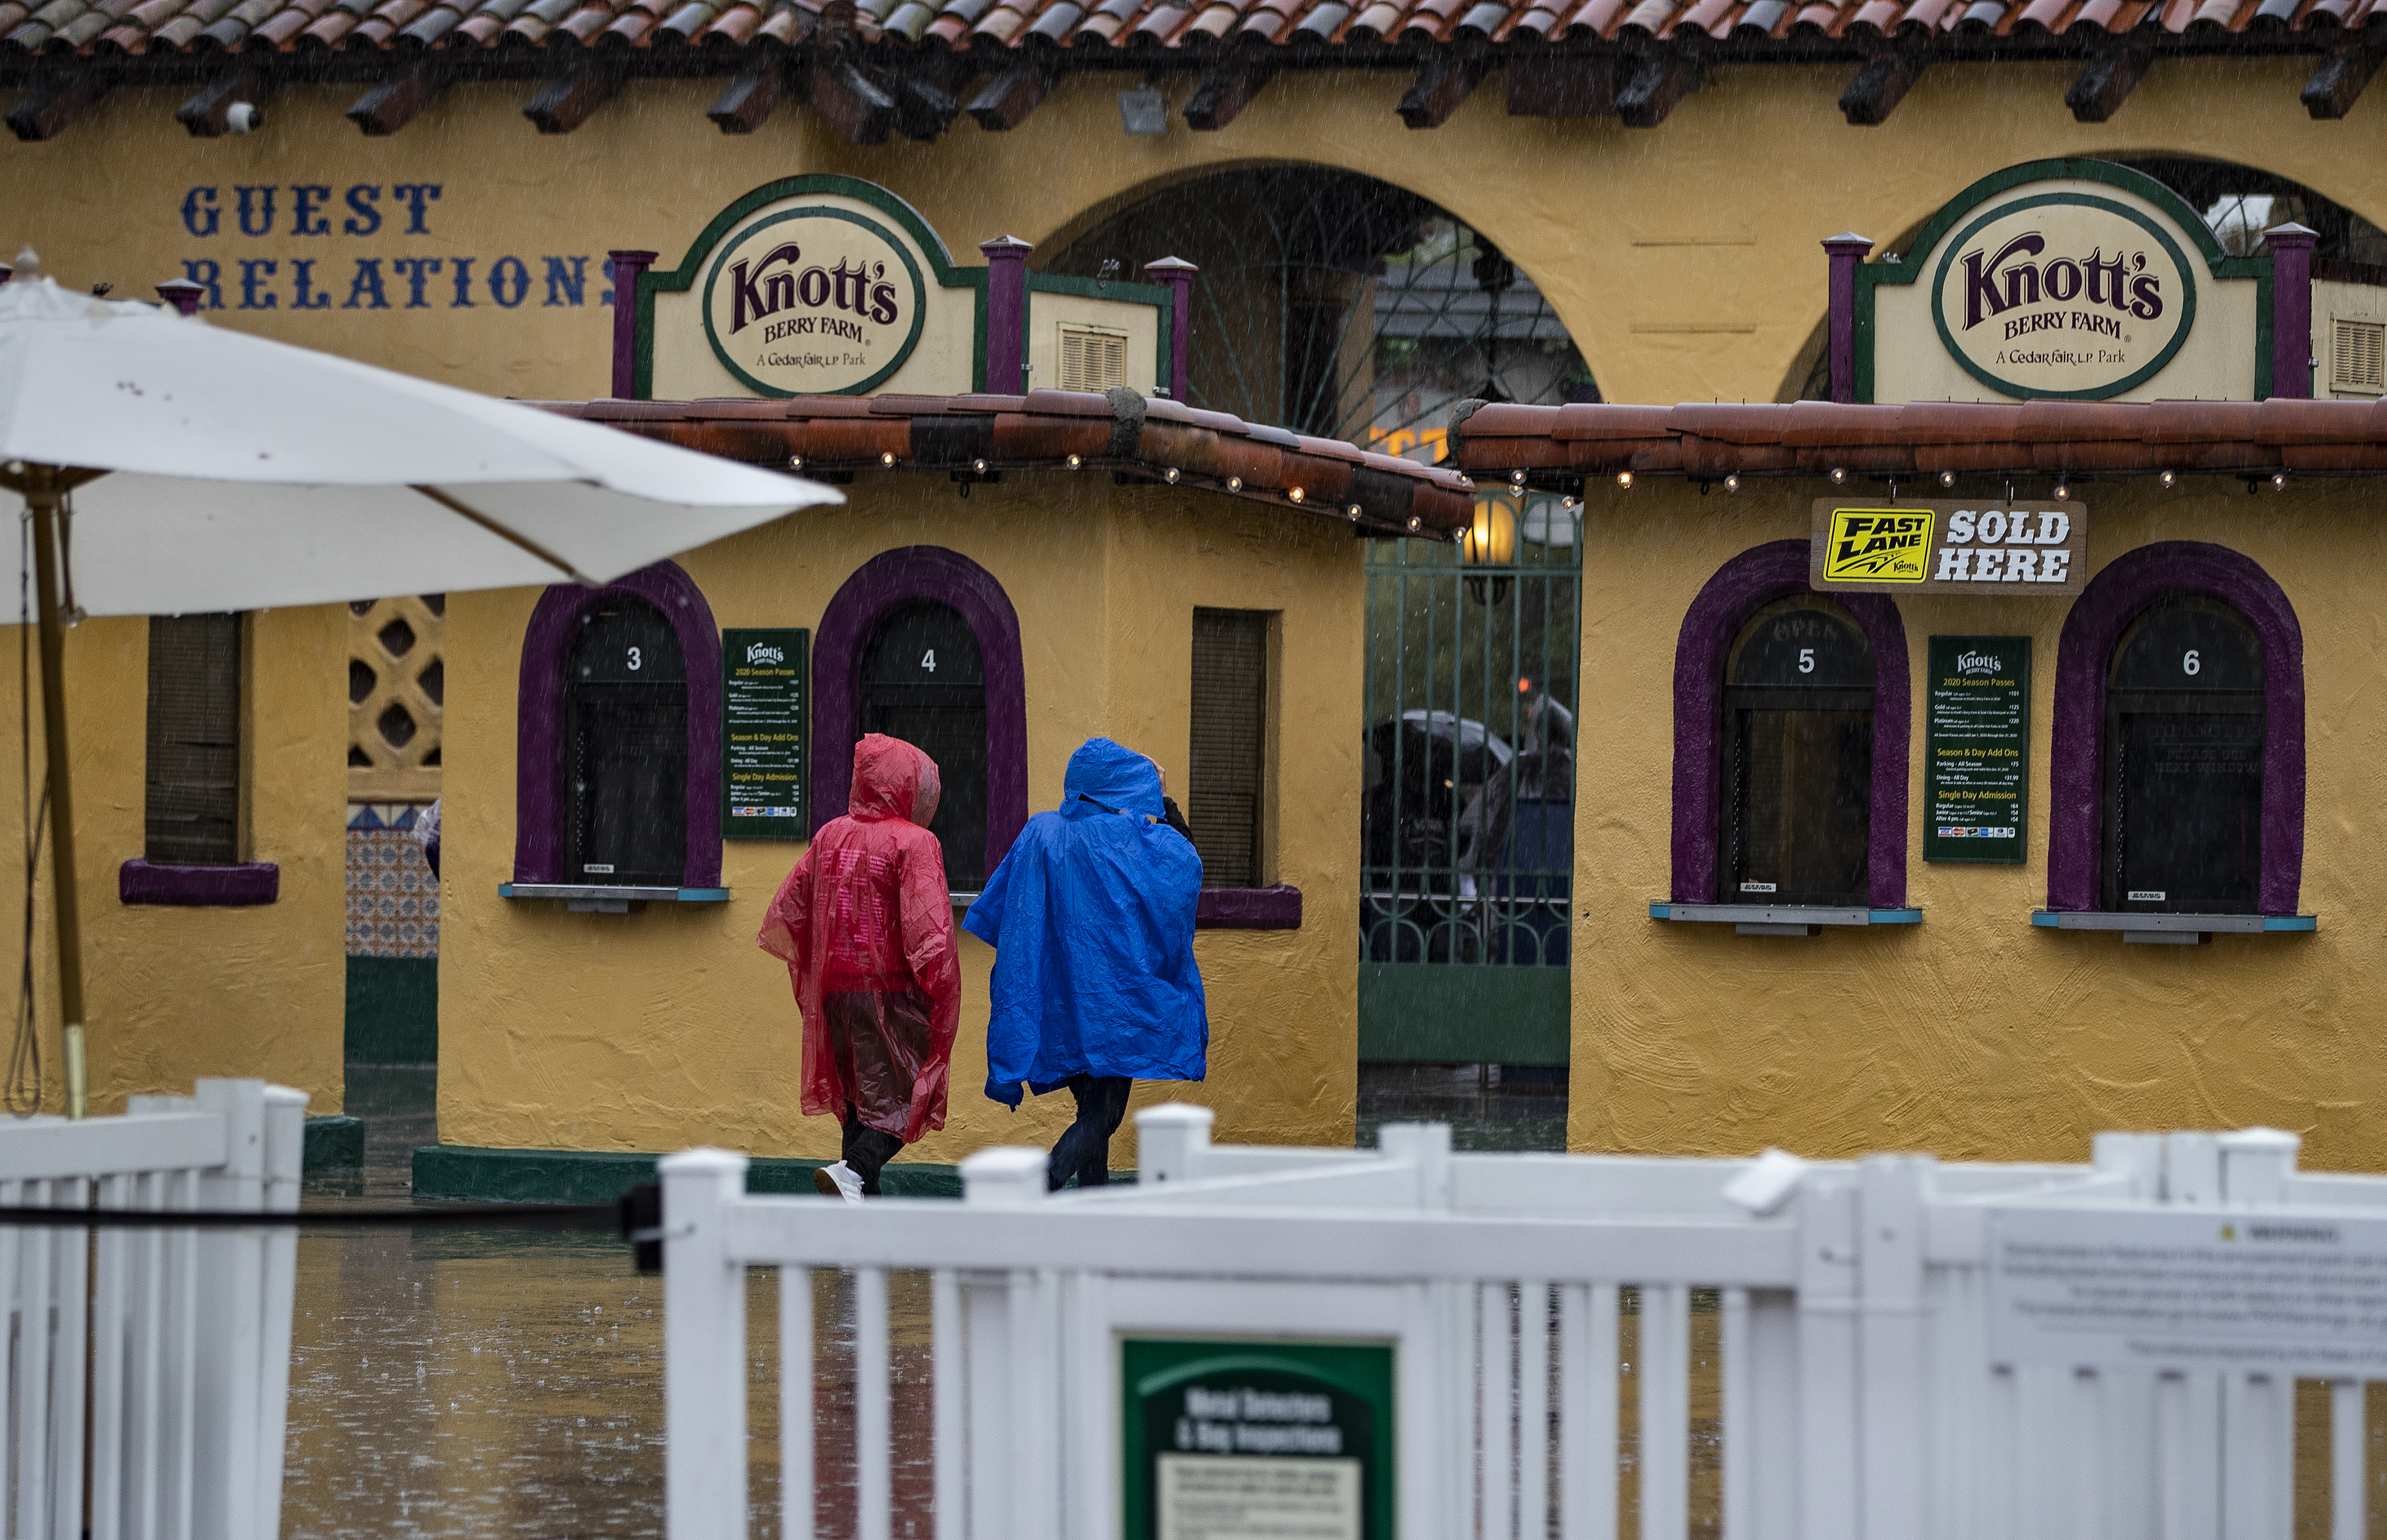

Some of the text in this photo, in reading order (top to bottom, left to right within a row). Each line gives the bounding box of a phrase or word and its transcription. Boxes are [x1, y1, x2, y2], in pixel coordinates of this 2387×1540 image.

[181, 184, 443, 237] GUEST
[182, 256, 614, 310] RELATION
[728, 242, 898, 335] Knott's
[1961, 231, 2163, 331] Knott's
[765, 316, 862, 345] BERRY FARM
[2004, 312, 2120, 340] BERRY FARM
[757, 354, 765, 366] A
[843, 353, 865, 366] Park
[1996, 349, 2005, 364] A
[2099, 349, 2125, 364] Park
[1843, 517, 1926, 537] FAST
[1946, 510, 2071, 545] SOLD
[1836, 533, 1921, 564] LANE
[1933, 548, 2071, 583] HERE
[627, 646, 641, 671] 3
[747, 642, 784, 663] Knott's
[921, 649, 936, 672] 4
[1798, 648, 1815, 673] 5
[1957, 650, 2001, 673] Knott's
[2183, 649, 2200, 675] 6
[760, 734, 772, 742] Day
[1938, 748, 2019, 758] Season & Day Add Ons
[733, 773, 751, 782] Single
[752, 773, 764, 782] Day
[1938, 790, 2017, 801] Single Day Admission
